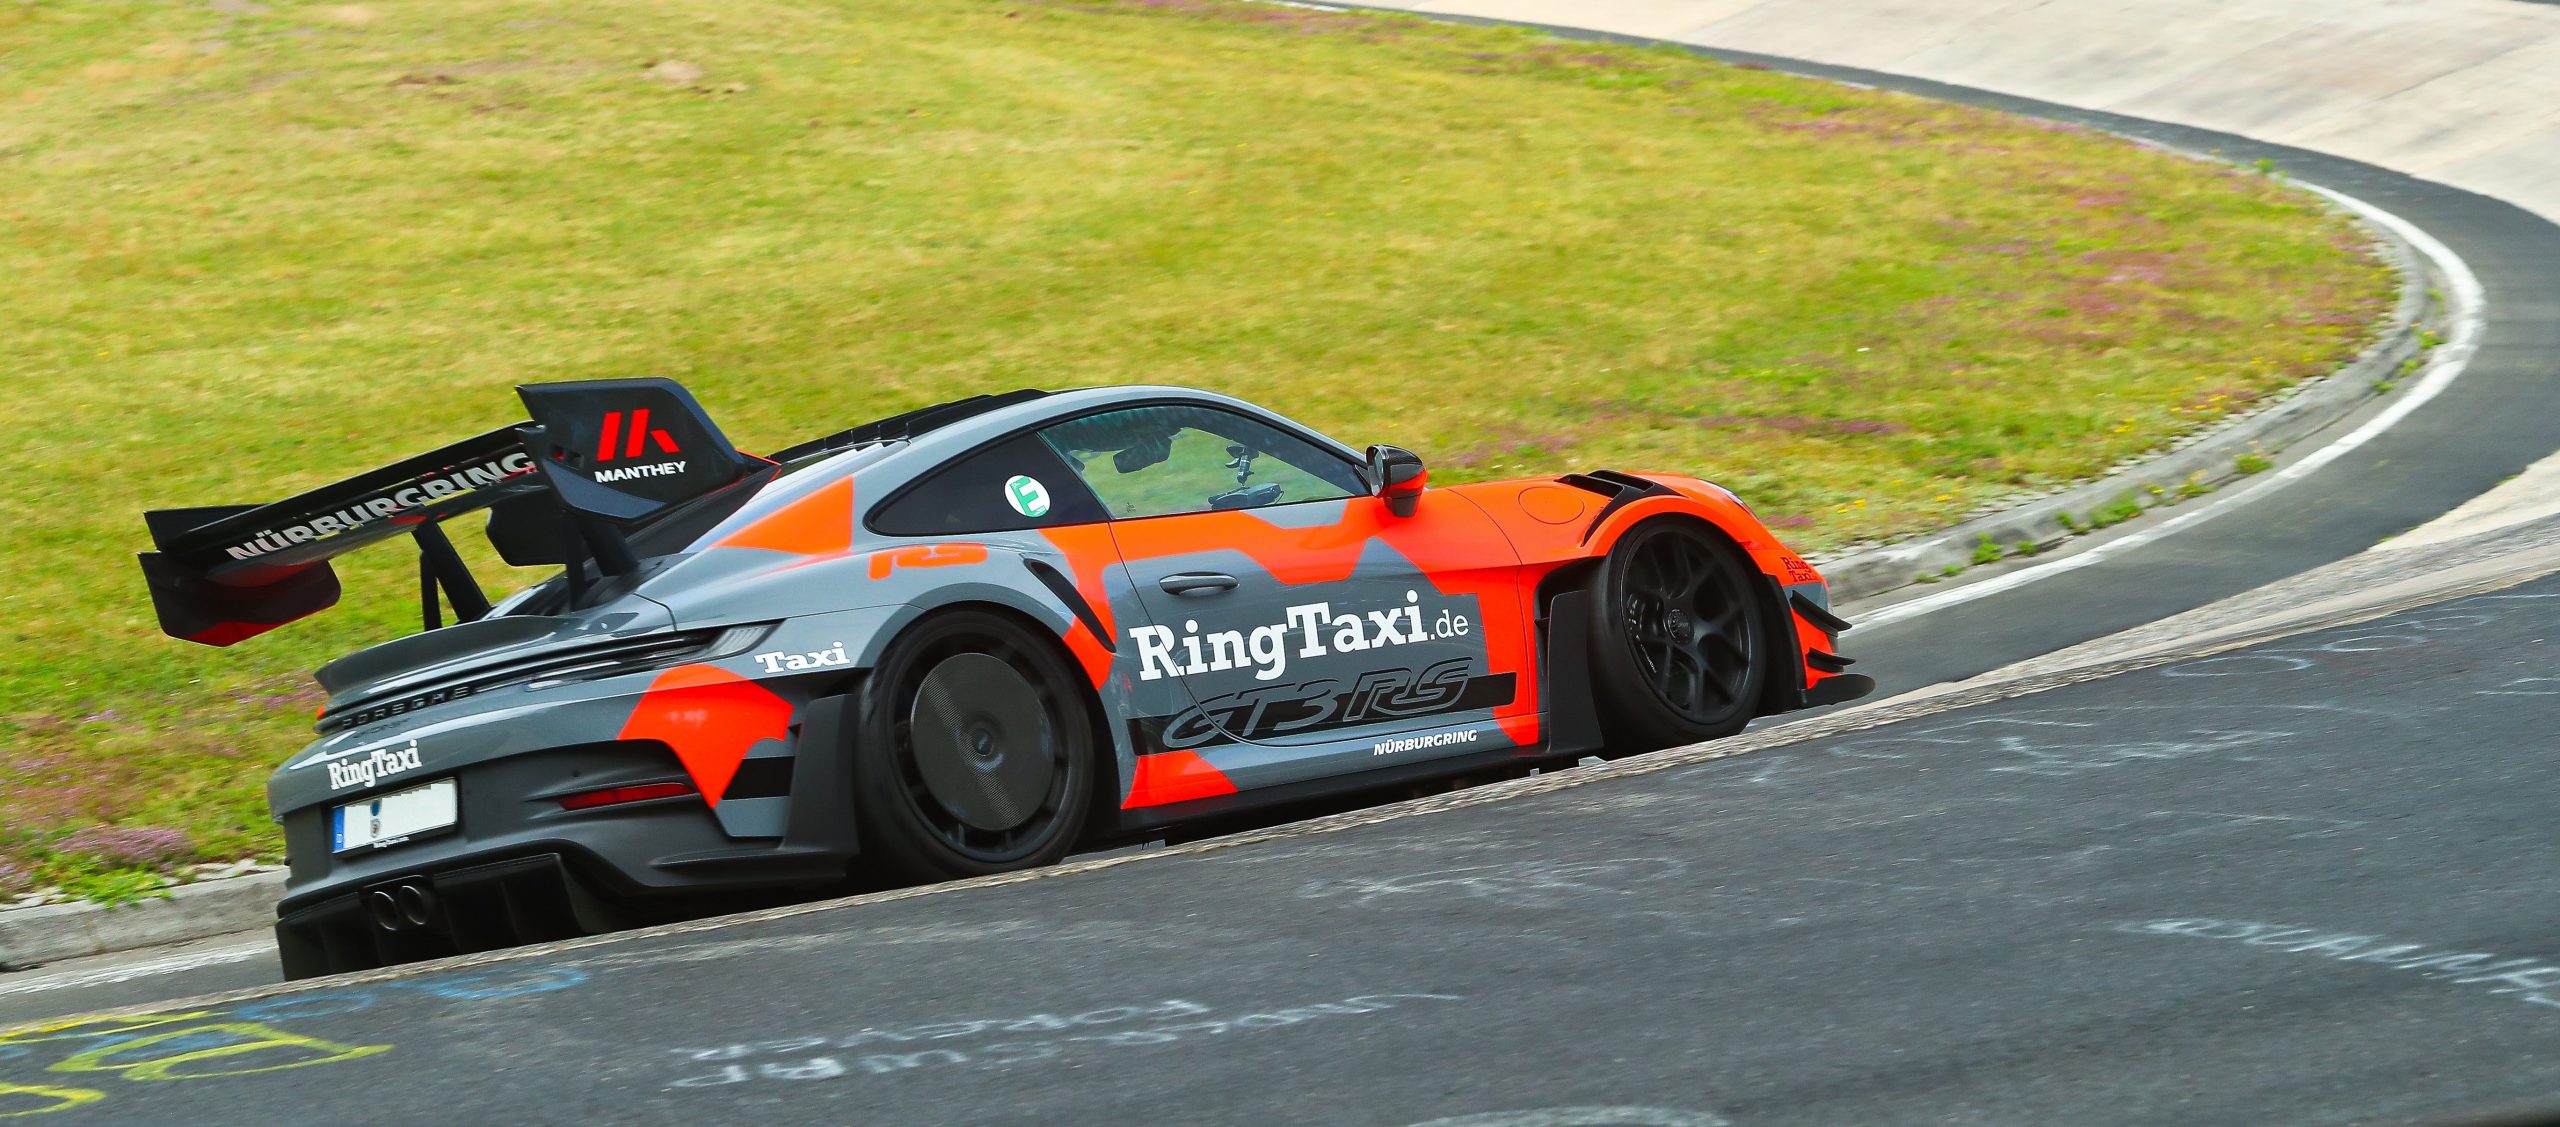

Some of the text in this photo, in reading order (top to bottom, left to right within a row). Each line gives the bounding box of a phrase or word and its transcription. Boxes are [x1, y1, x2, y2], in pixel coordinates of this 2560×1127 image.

[594, 460, 687, 483] MANTHEY
[225, 452, 538, 561] NÜRBURGRING
[1010, 476, 1047, 517] E
[867, 541, 989, 581] RS
[1129, 589, 1470, 681] RingTaxi.de
[754, 641, 850, 674] Taxi
[342, 685, 471, 728] PORSCHE
[1373, 729, 1477, 756] NÜRBURGRING
[327, 739, 422, 790] RingTaxi
